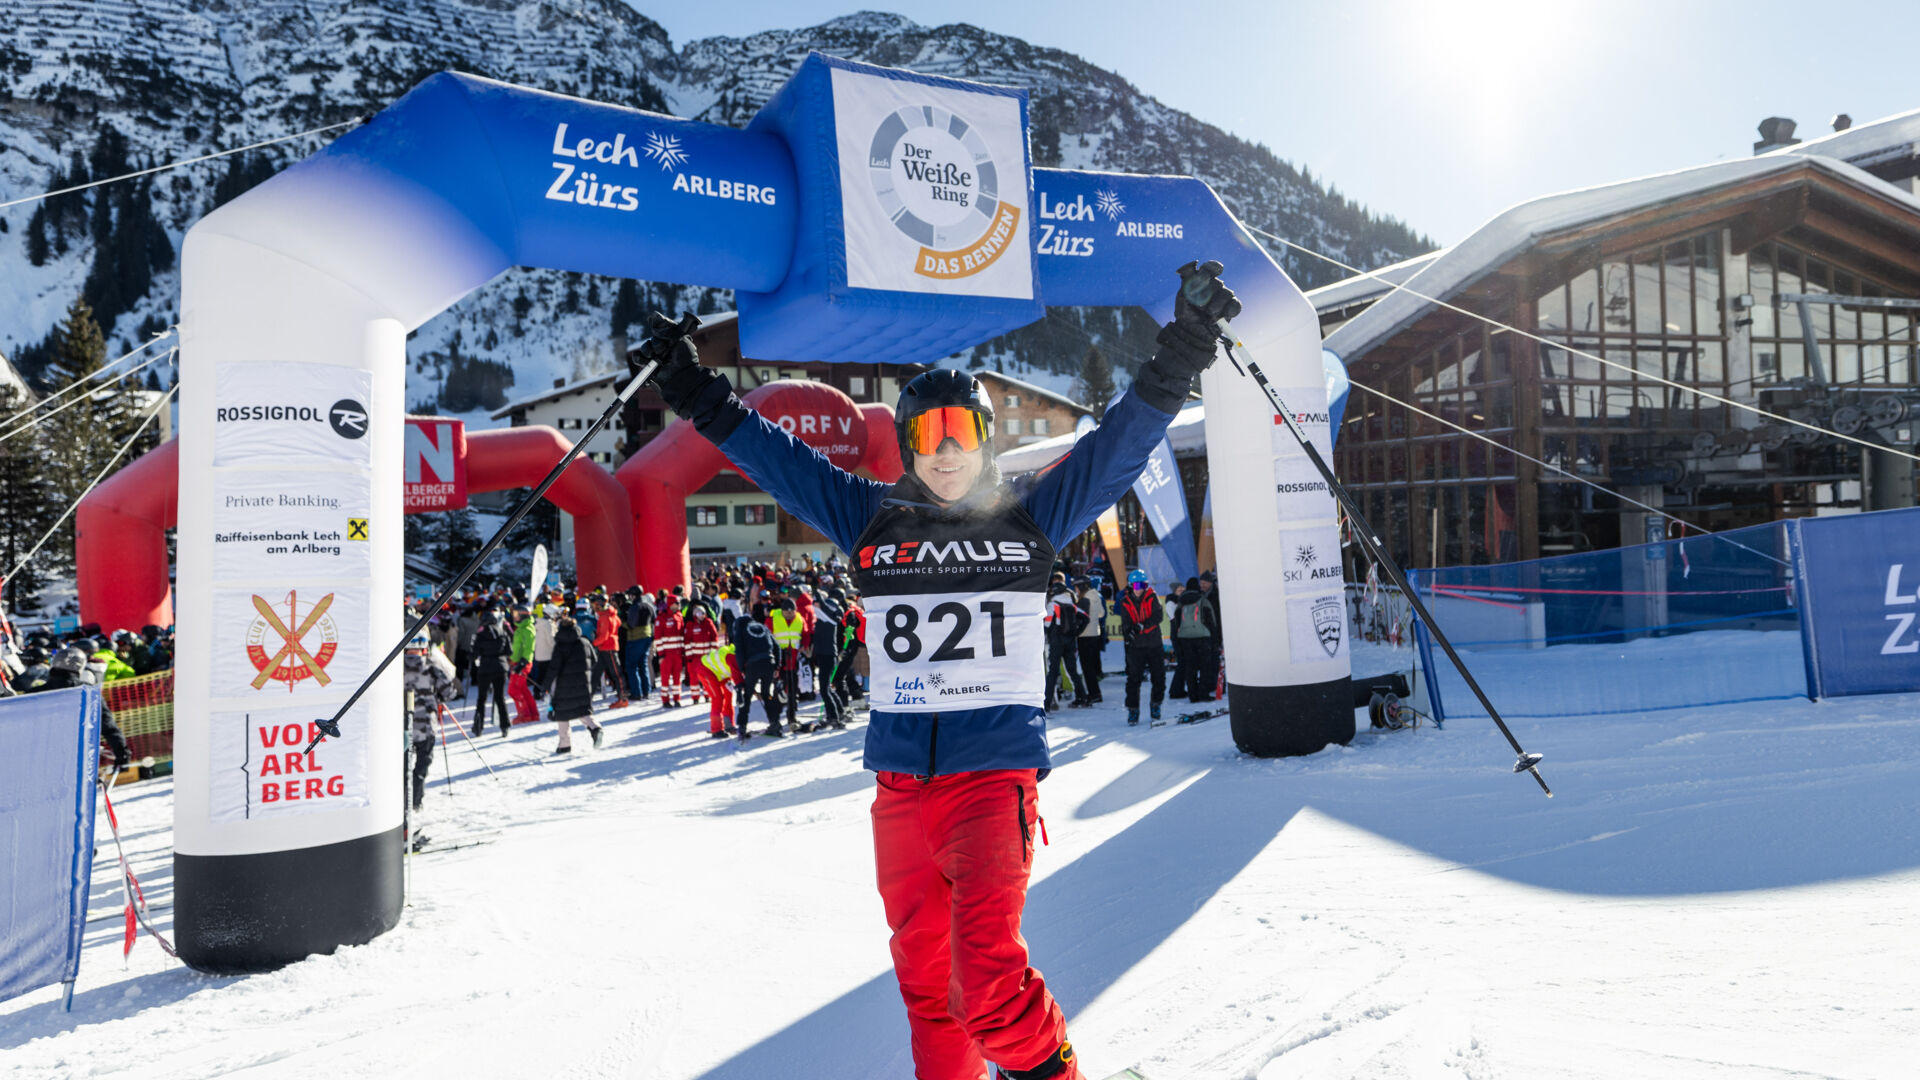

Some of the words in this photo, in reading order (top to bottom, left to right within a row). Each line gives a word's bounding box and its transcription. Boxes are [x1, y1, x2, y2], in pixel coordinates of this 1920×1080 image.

[552, 122, 639, 168] Lech
[903, 142, 932, 159] Der
[900, 158, 972, 188] Weiße
[544, 161, 639, 211] Zürs
[672, 173, 776, 206] ARLBERG
[931, 185, 969, 208] Ring
[1039, 191, 1095, 222] Lech
[1036, 224, 1095, 257] Zürs
[1116, 221, 1183, 239] ARLBERG
[923, 255, 960, 274] DAS
[962, 209, 1015, 271] RENNEN
[217, 405, 324, 422] ROSSIGNOL
[777, 414, 832, 434] ORF
[838, 417, 852, 435] V
[403, 483, 455, 496] LBERGER
[1277, 481, 1328, 493] ROSSIGNOL
[225, 494, 275, 508] Private
[278, 494, 342, 509] Banking.
[404, 495, 447, 506] ICHTEN
[215, 530, 309, 543] Raiffeisenbank
[313, 530, 341, 541] Lech
[266, 546, 288, 555] am
[292, 543, 341, 556] Arlberg
[872, 540, 1032, 566] REMUS
[873, 565, 934, 577] PERFORMANCE
[937, 566, 973, 575] SPORT
[976, 565, 1032, 574] EXHAUSTS
[1283, 569, 1303, 582] SKI
[249, 620, 267, 645] CLUB
[882, 601, 1007, 664] 821
[1880, 612, 1920, 655] Z
[894, 675, 925, 691] Lech
[939, 684, 991, 697] ARLBERG
[893, 690, 927, 705] Zürs
[260, 749, 323, 778] ARL
[261, 774, 345, 804] BERG
